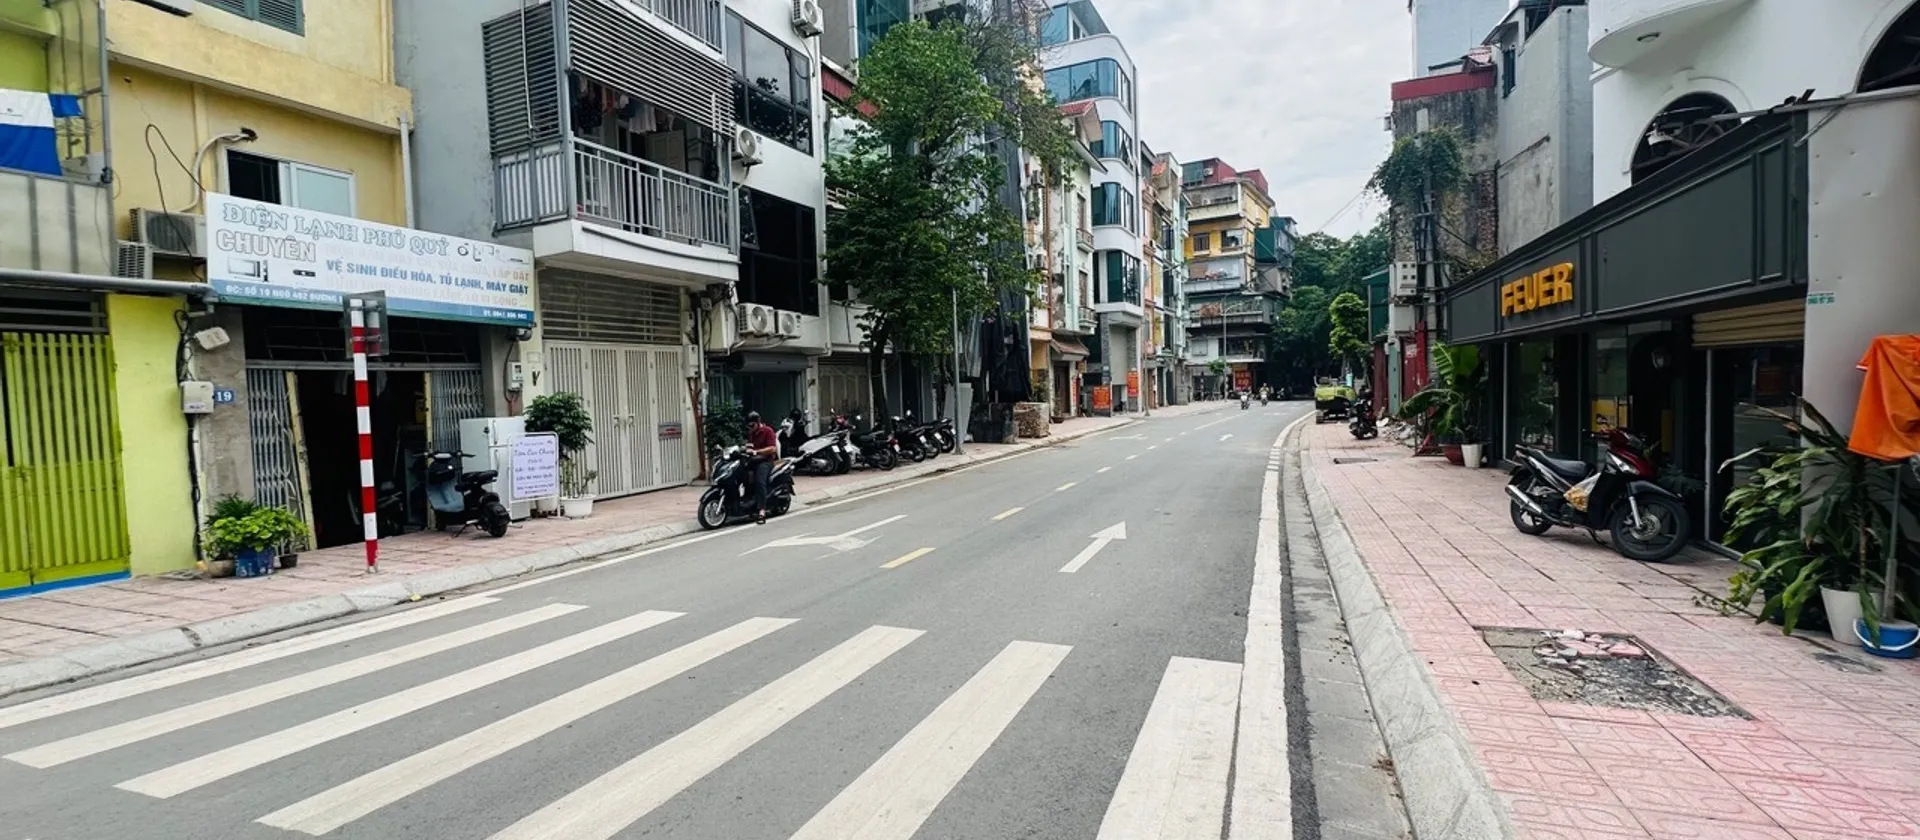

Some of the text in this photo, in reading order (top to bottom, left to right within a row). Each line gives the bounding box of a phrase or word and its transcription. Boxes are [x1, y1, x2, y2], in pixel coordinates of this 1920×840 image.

[223, 203, 288, 231] ĐIỆN
[294, 216, 359, 242] LẠNH
[216, 229, 316, 262] CHUYÊN
[326, 257, 344, 274] VỆ
[347, 262, 377, 276] SINH
[486, 281, 506, 292] MÁY
[509, 283, 528, 296] GIẬT
[1501, 262, 1573, 317] FEUER
[217, 391, 231, 402] 19
